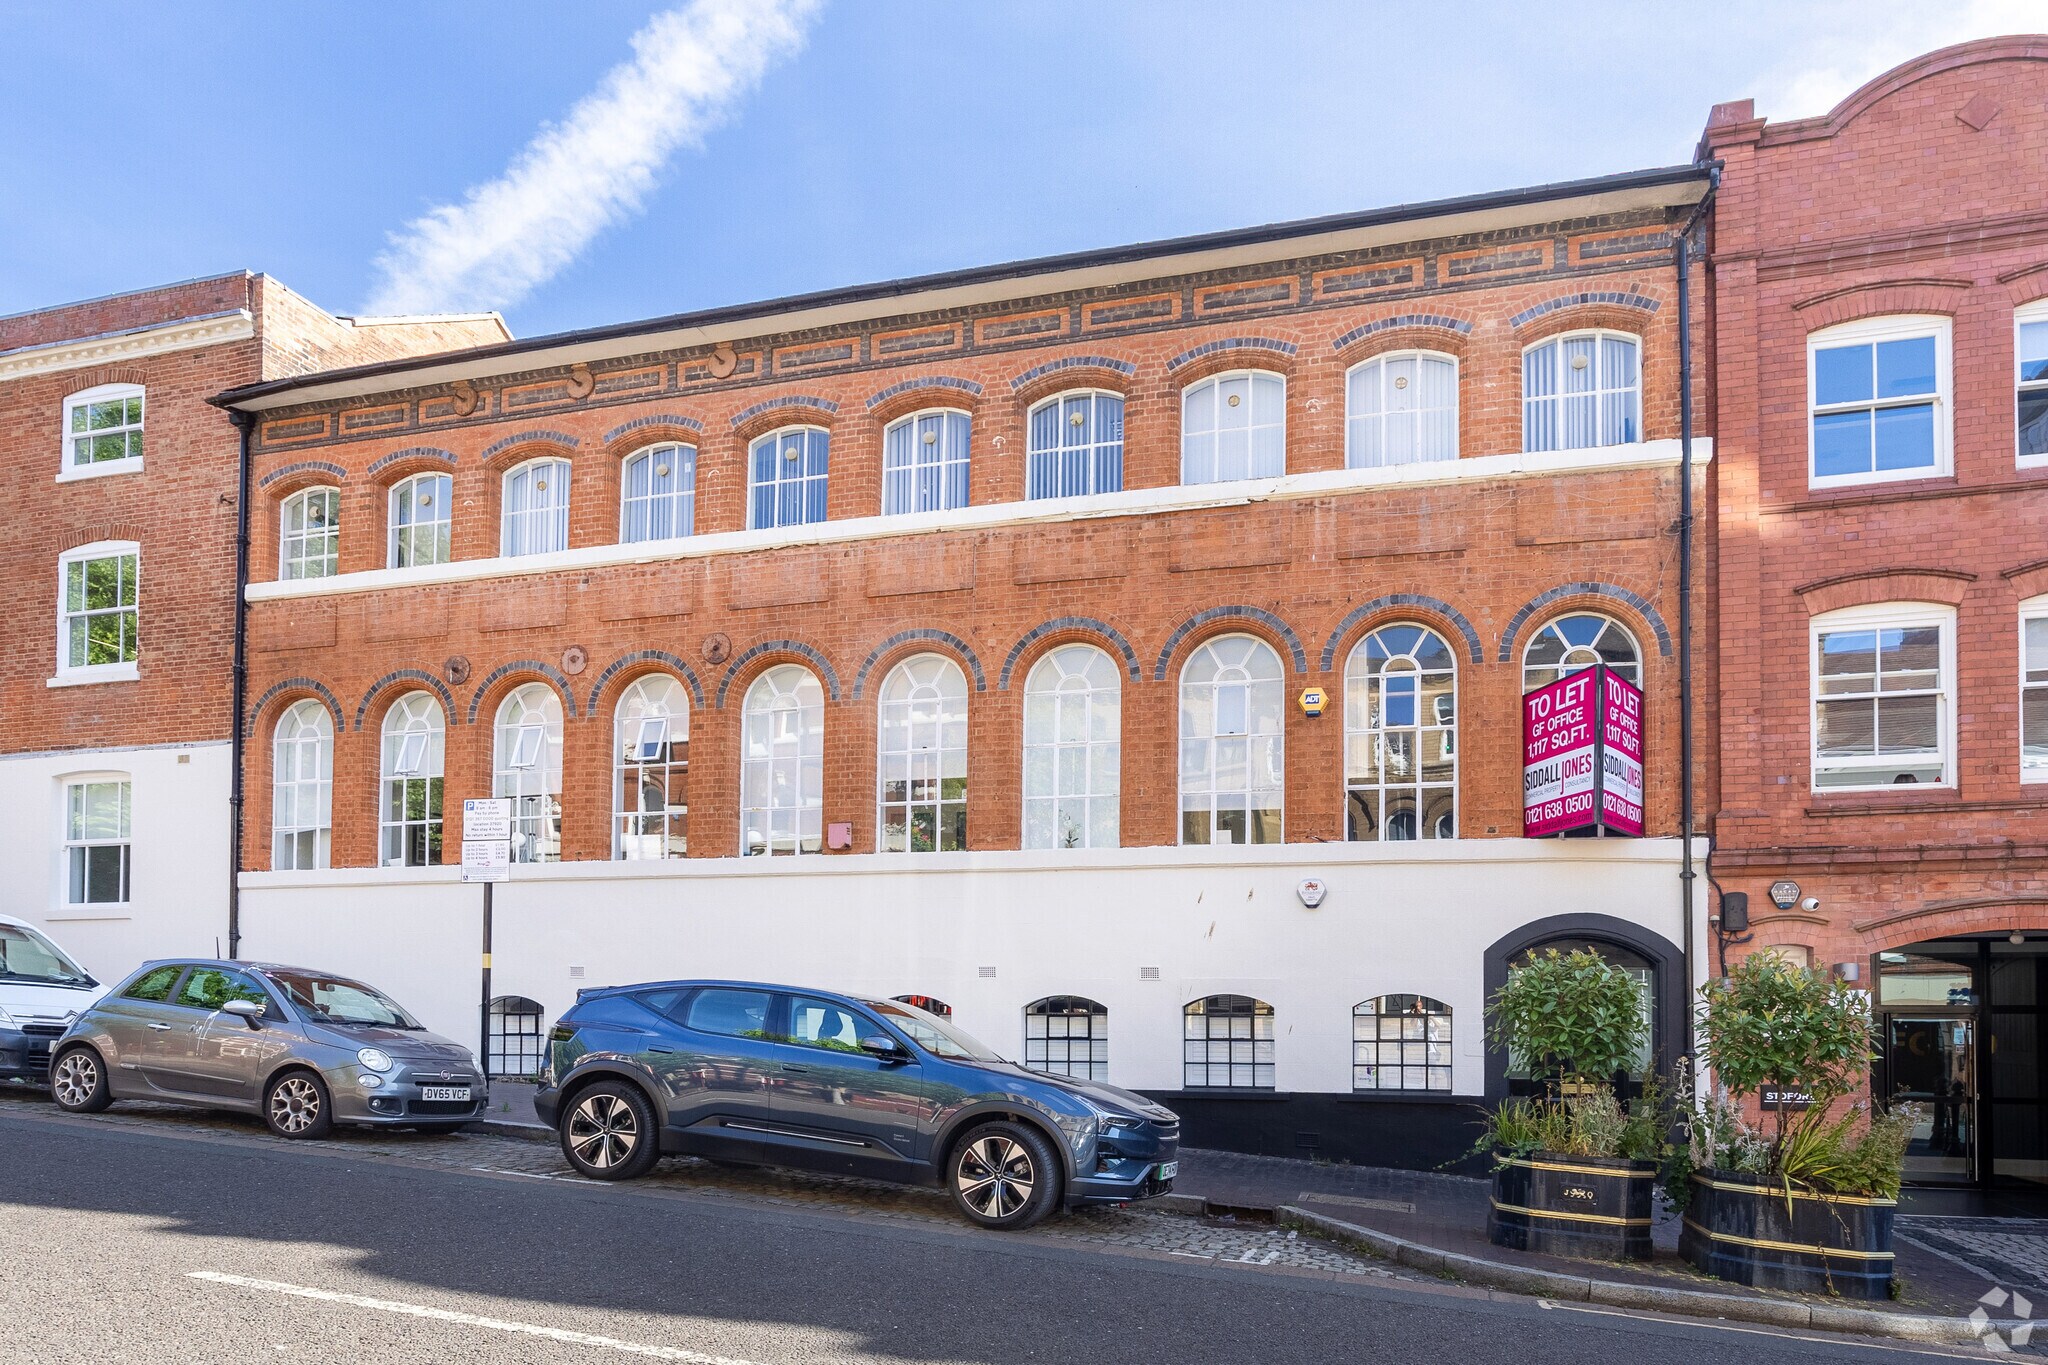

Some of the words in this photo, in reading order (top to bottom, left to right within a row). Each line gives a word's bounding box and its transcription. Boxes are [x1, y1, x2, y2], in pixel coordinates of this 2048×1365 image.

[1529, 694, 1550, 720] TO
[1556, 677, 1589, 711] LET
[1607, 677, 1621, 705] TO
[1623, 688, 1639, 717] LET
[1532, 722, 1545, 737] GF
[1548, 707, 1583, 731] OFFICE
[1610, 706, 1619, 721] GF
[1620, 712, 1638, 735] OFFICE
[1528, 738, 1548, 759] 1,117
[1551, 724, 1590, 749] SQ.FT.
[1606, 723, 1621, 743] 1,117
[1622, 731, 1640, 756] SQ.FT.
[1526, 763, 1560, 791] SIDDALL
[1560, 753, 1592, 795] JONES
[1604, 753, 1626, 781] SIDDALL
[1544, 784, 1560, 794] PROPERTY
[1565, 777, 1591, 788] CONSULTANCY
[1525, 806, 1542, 824] 0121
[1545, 801, 1563, 819] 638
[1566, 793, 1592, 814] 0500
[1603, 793, 1616, 812] 0121
[1617, 799, 1626, 817] 638
[1627, 805, 1641, 823] 0500
[427, 1089, 449, 1099] DV65
[1766, 1092, 1815, 1100] STOFOR
